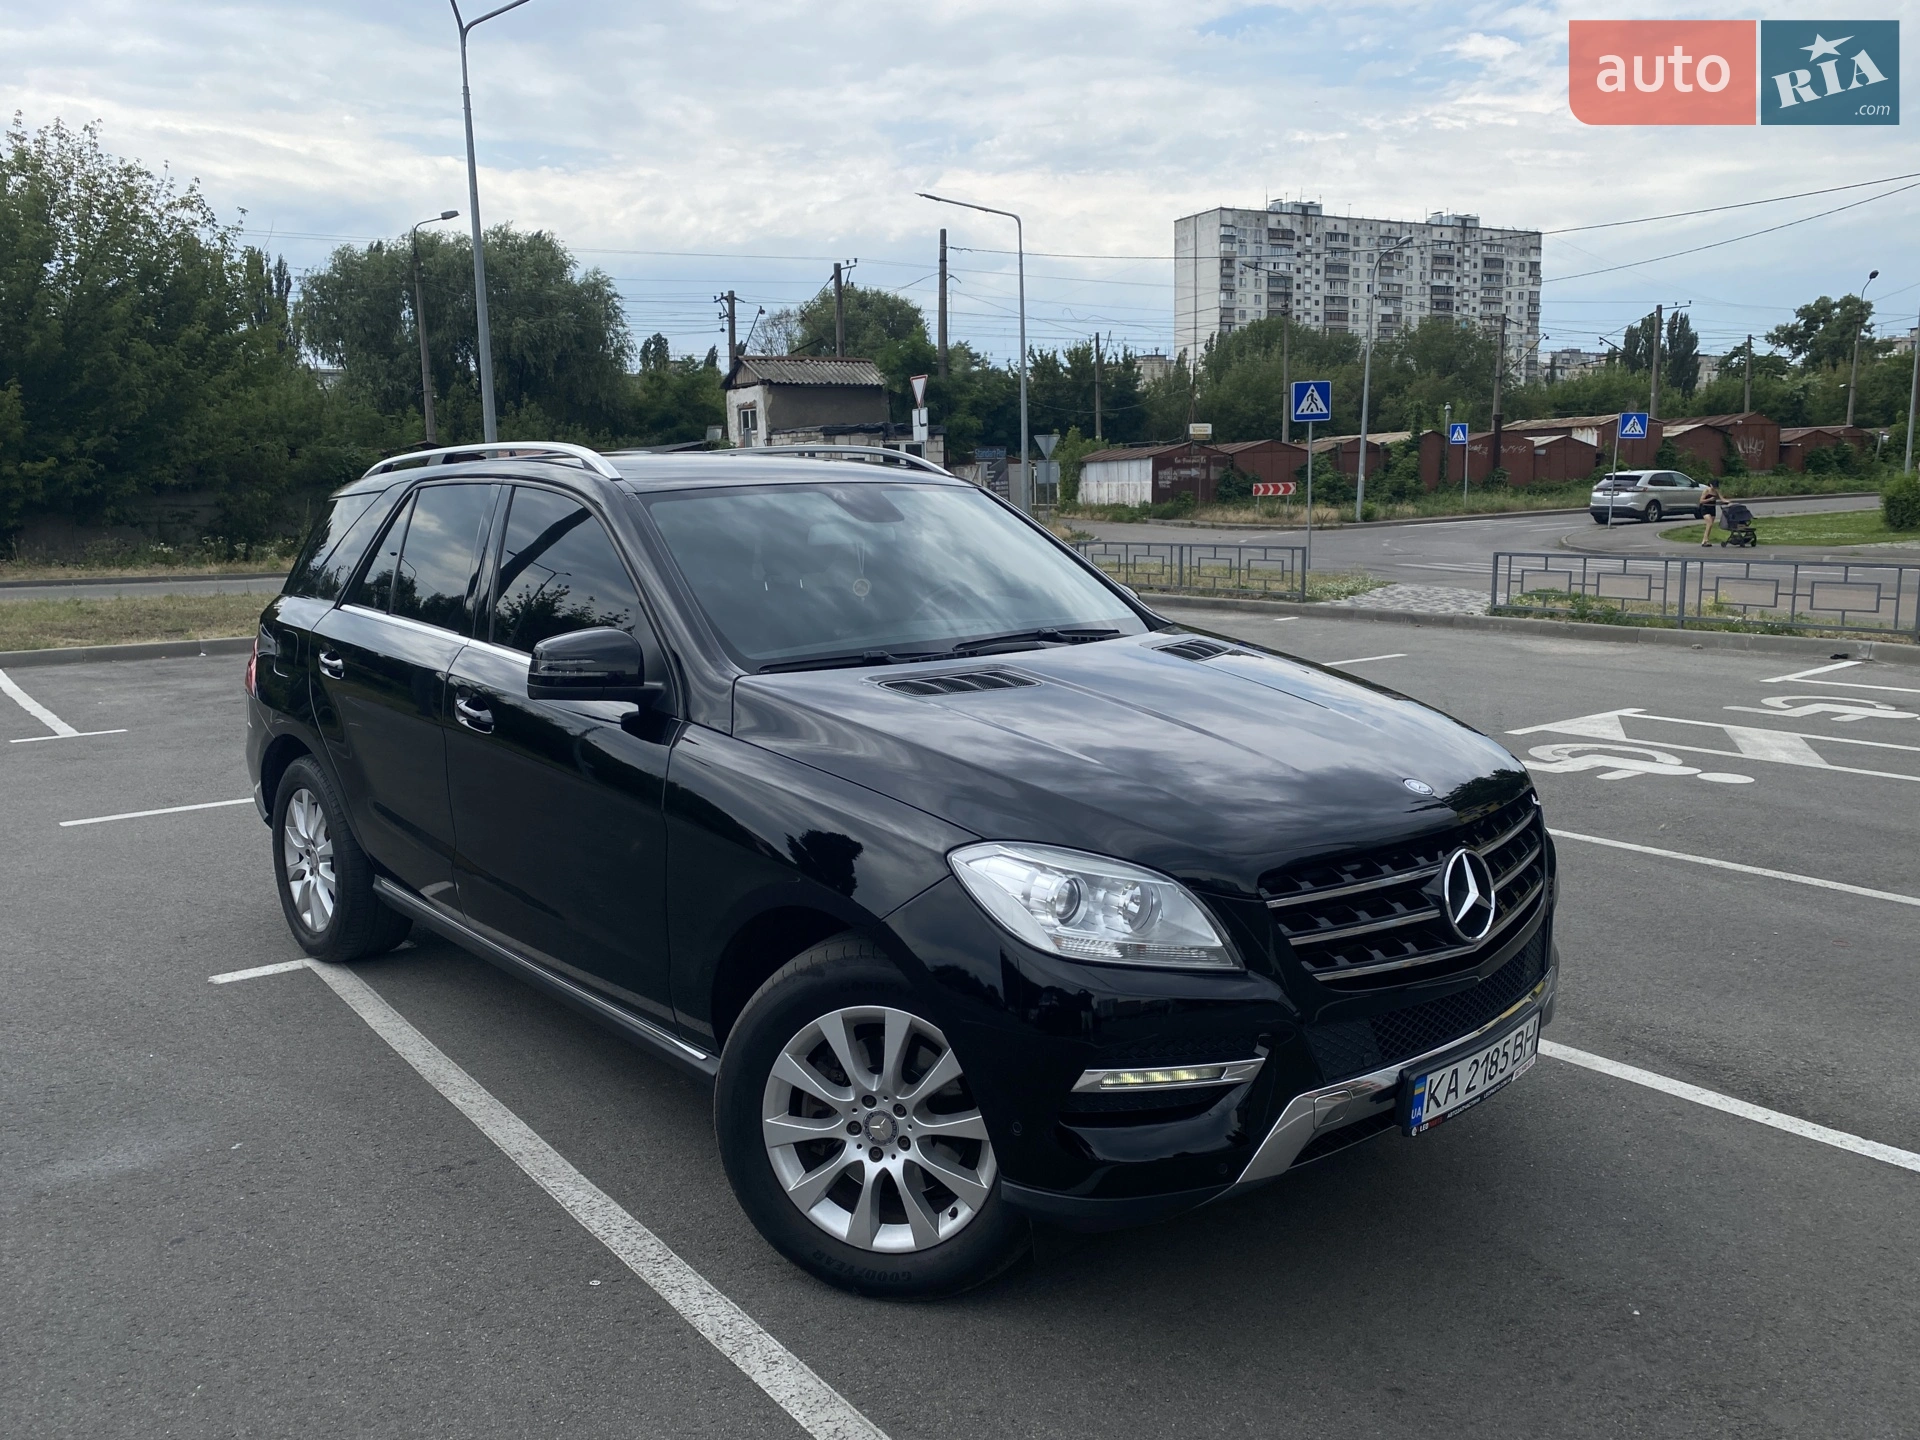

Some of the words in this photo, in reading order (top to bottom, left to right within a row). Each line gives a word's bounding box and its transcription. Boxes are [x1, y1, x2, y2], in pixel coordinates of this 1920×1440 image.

[1425, 1067, 1459, 1114] KA
[1464, 1038, 1511, 1095] 2185
[1511, 1019, 1537, 1067] BH
[1411, 1106, 1422, 1120] UA
[812, 1248, 914, 1282] GOODYEAR
